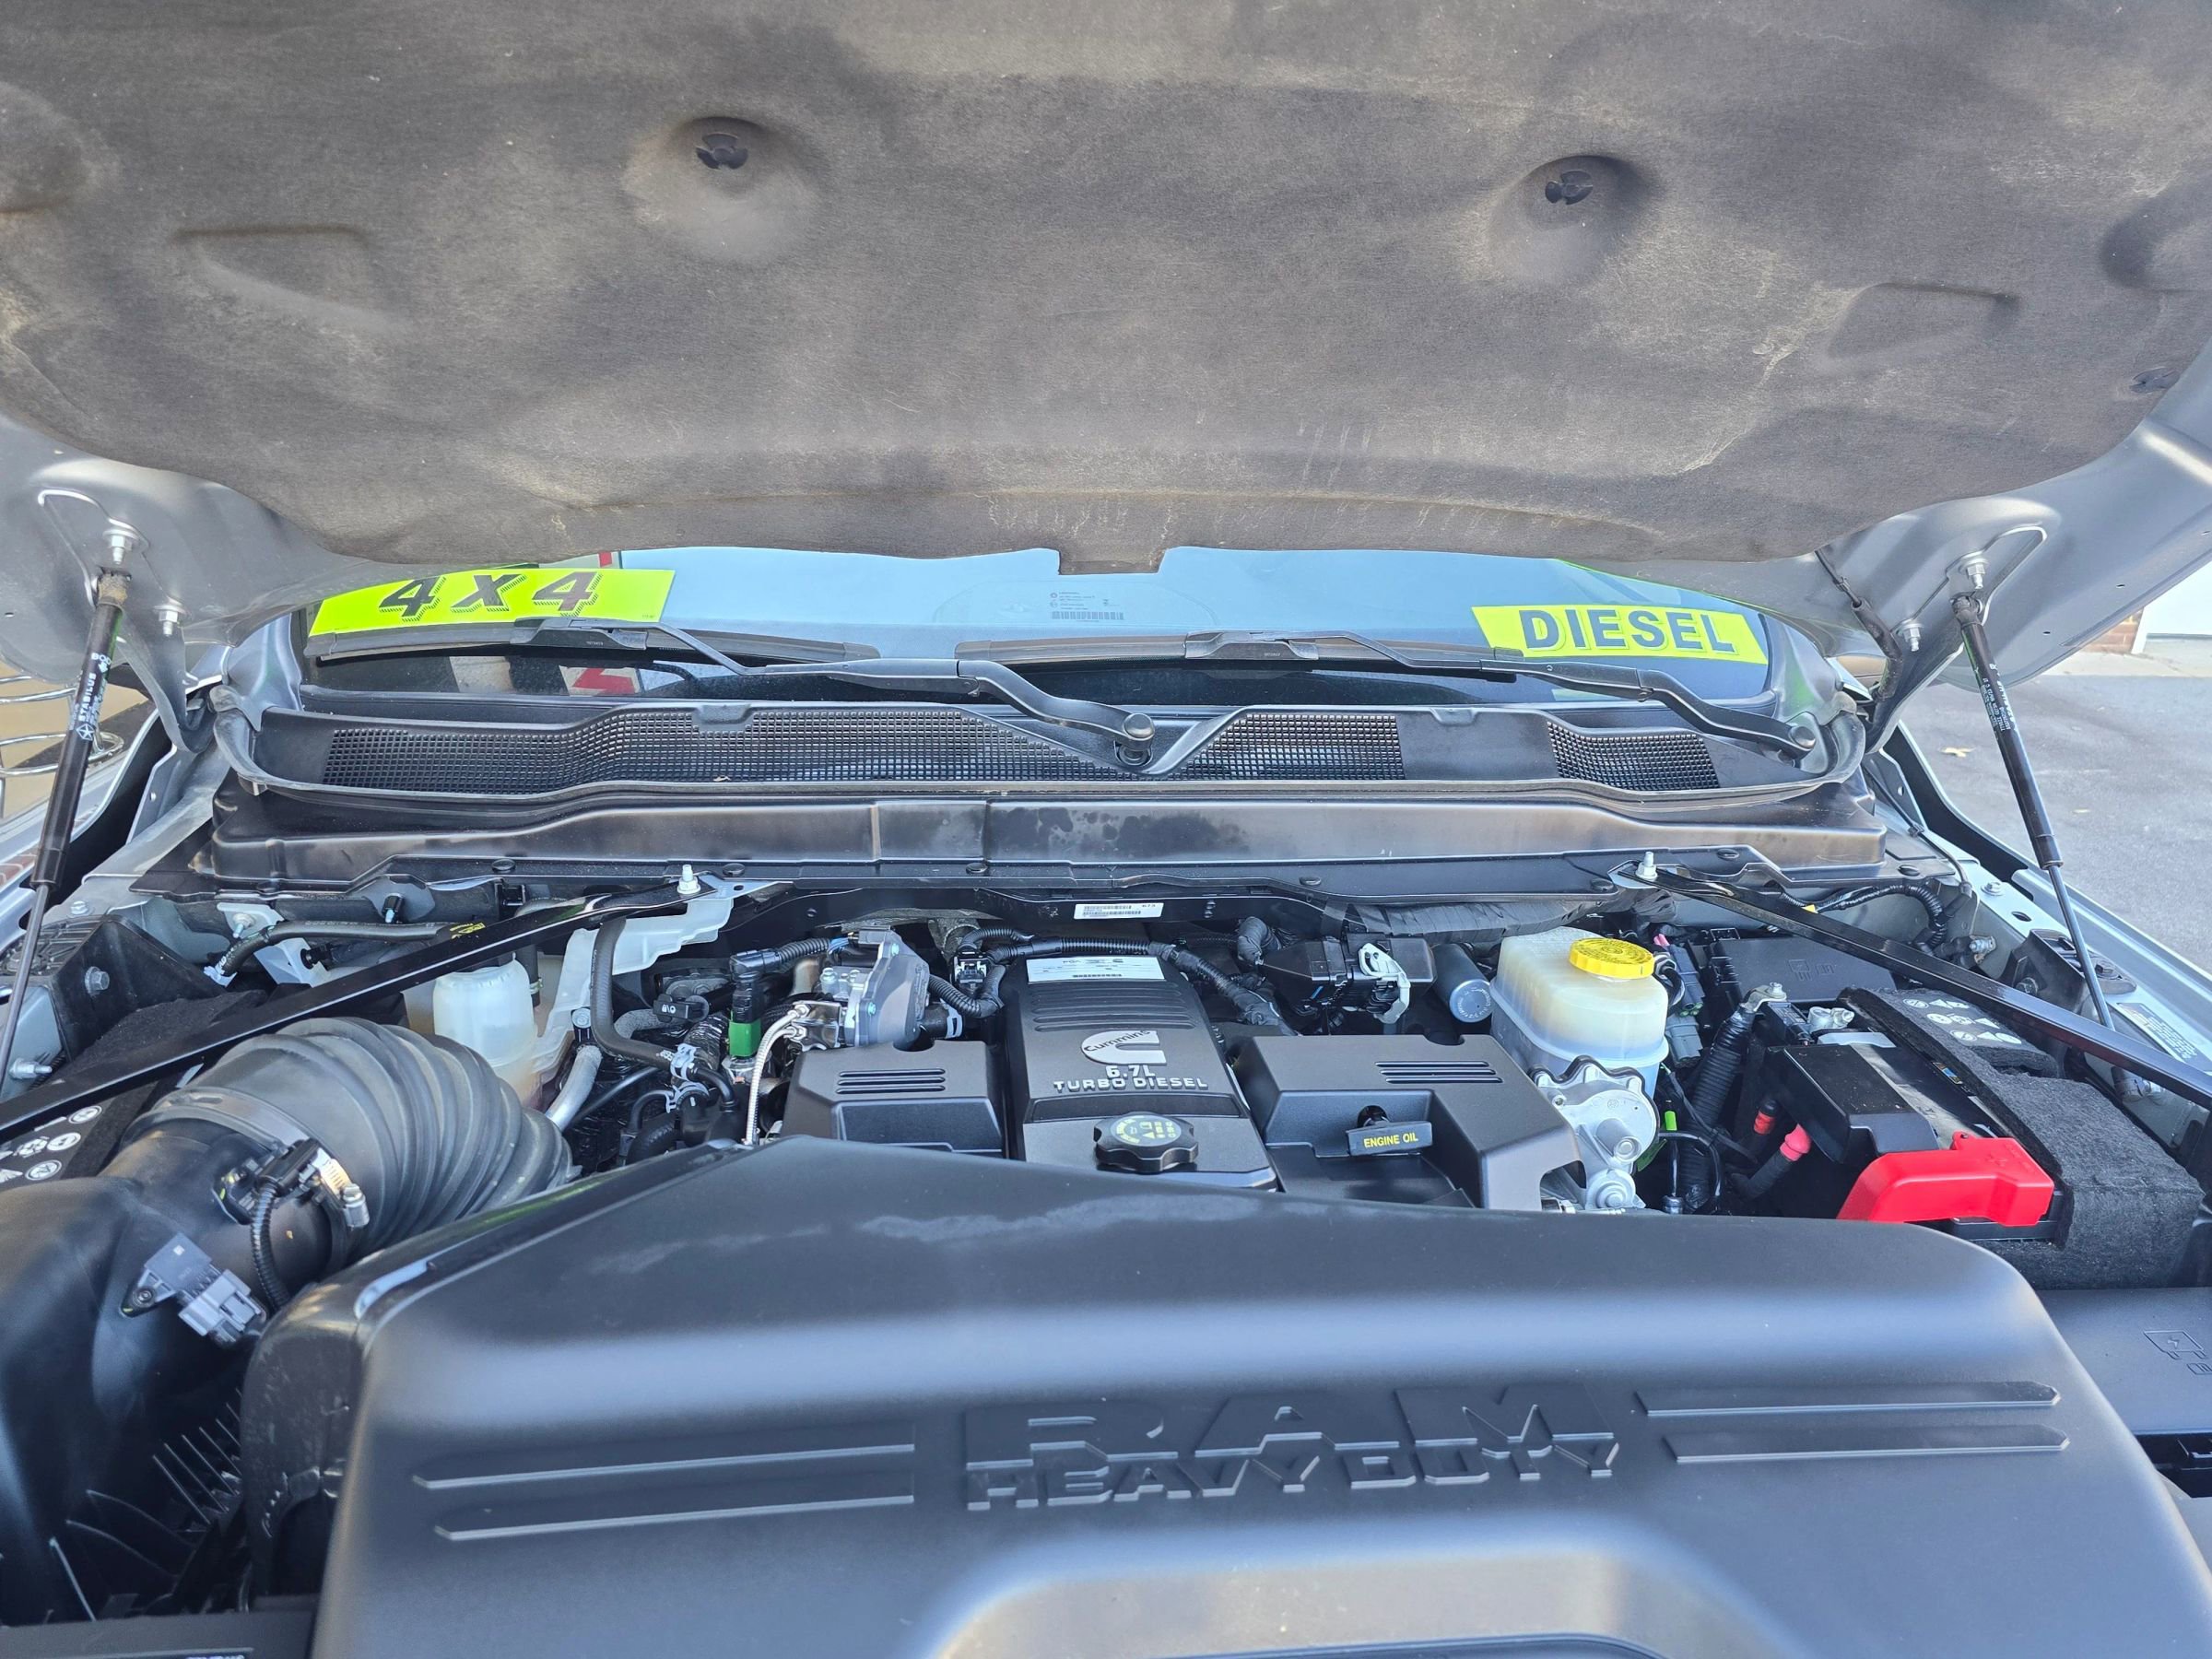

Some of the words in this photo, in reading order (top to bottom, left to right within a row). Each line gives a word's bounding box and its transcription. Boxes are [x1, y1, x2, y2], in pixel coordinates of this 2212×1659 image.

[1518, 607, 1740, 655] DIESEL
[1084, 1030, 1151, 1053] Cummins
[1106, 1065, 1156, 1079] 6.7L
[1053, 1077, 1126, 1092] TURBO
[1134, 1077, 1208, 1091] DIESEL
[1363, 1135, 1400, 1148] ENGINE
[1402, 1132, 1418, 1143] OIL
[962, 1384, 1615, 1471] RAM
[966, 1453, 1320, 1511] HEAVY
[1340, 1438, 1620, 1490] DUTY
